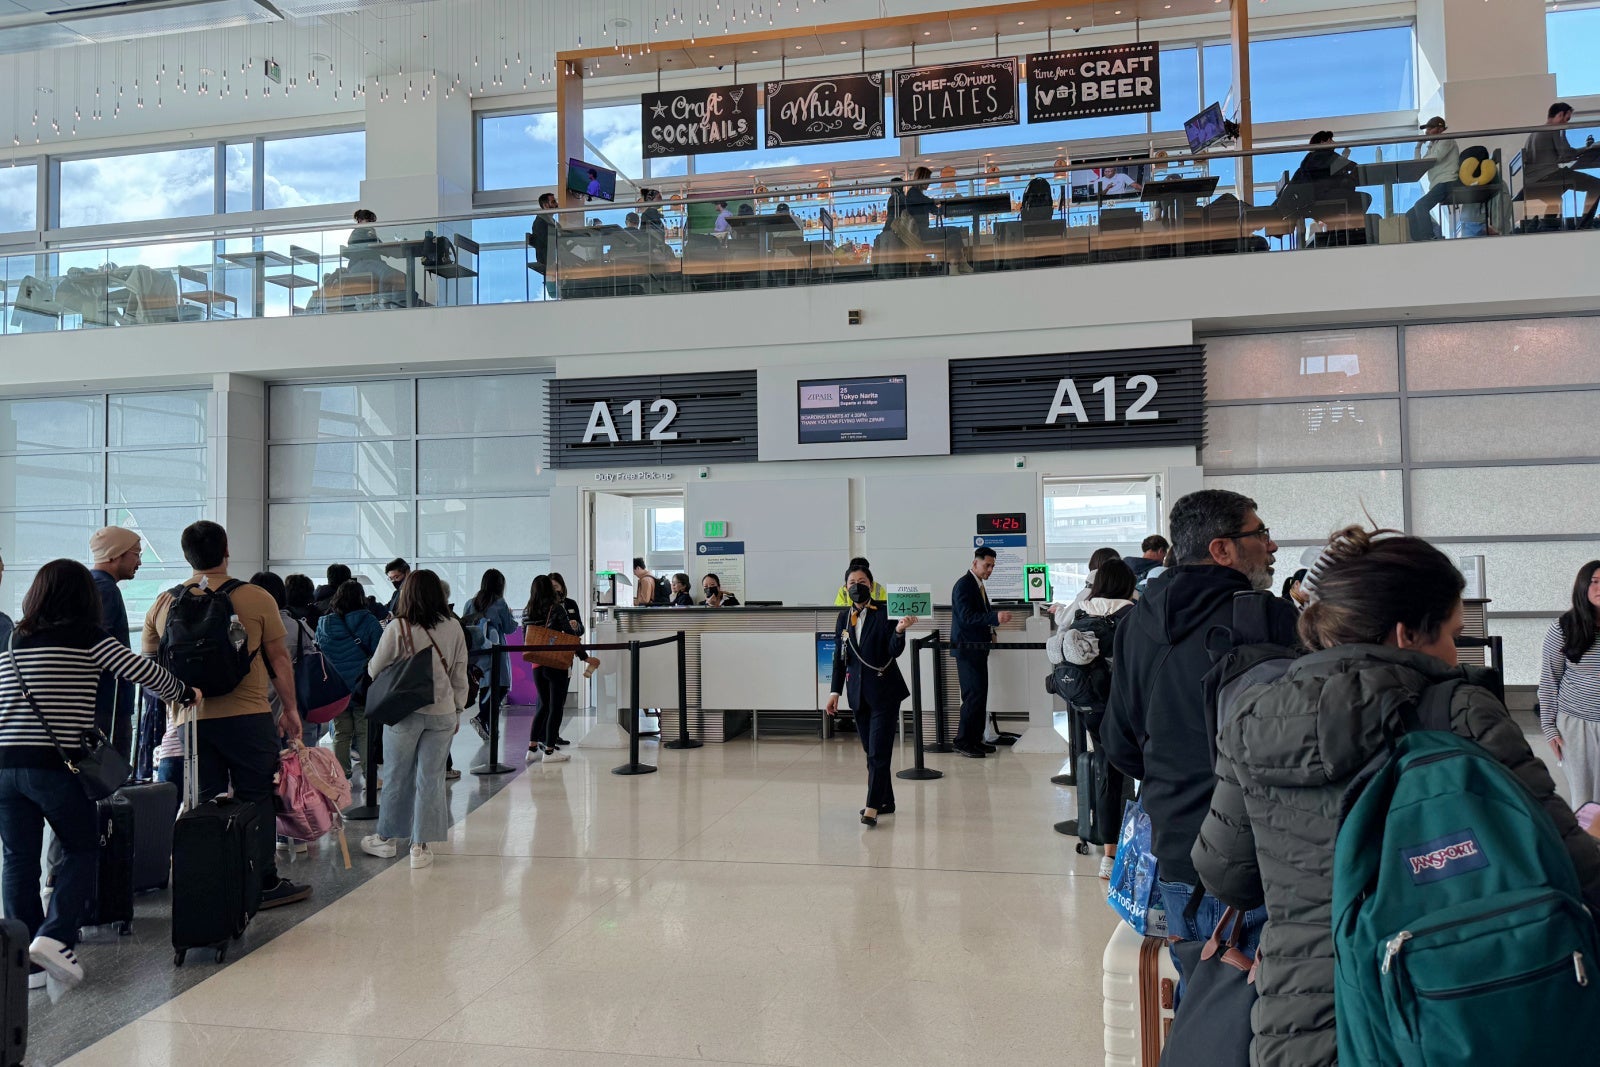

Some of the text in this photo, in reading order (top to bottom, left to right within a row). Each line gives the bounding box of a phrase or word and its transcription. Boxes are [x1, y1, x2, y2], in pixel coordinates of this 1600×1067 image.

[1080, 56, 1153, 77] CRAFT
[912, 71, 997, 93] CHEF-Driven
[1081, 76, 1153, 102] BEER
[671, 92, 723, 125] Craft
[780, 82, 867, 130] Whisky
[912, 85, 998, 121] PLATES
[651, 118, 749, 146] COCKTAILS
[807, 393, 833, 401] ZIPAIR
[840, 393, 859, 401] Tokyo
[1045, 374, 1159, 424] A12
[582, 398, 678, 443] A12
[594, 471, 673, 482] Duty Free Pick-up
[992, 517, 1019, 530] 4:26
[891, 601, 927, 614] 24-57
[1409, 840, 1474, 875] JANSPORT
